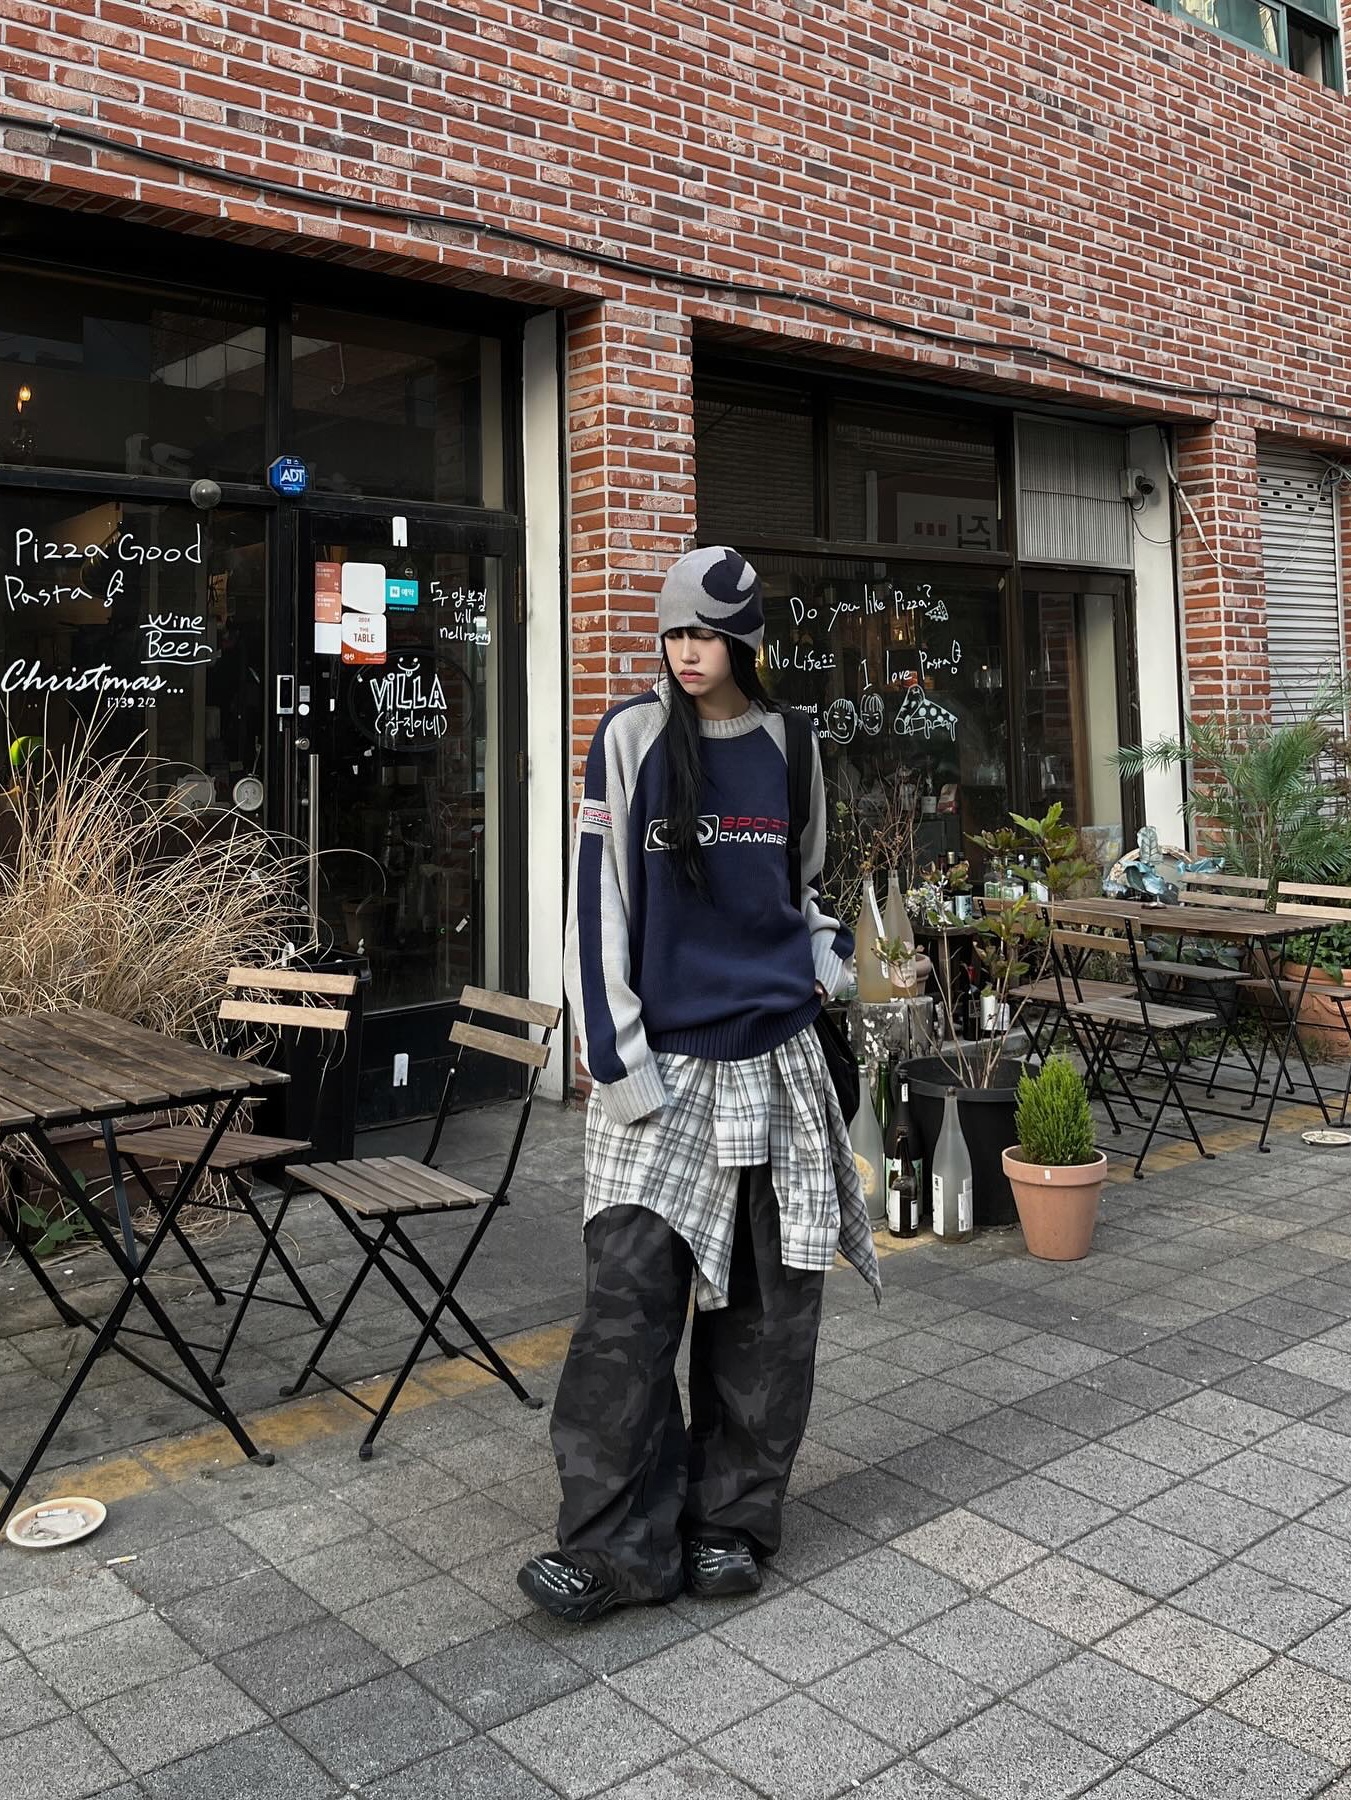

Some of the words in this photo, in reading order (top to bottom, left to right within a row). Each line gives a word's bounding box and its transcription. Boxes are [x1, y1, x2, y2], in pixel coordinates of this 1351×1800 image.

[281, 468, 305, 482] ADT
[16, 528, 109, 566] Pizza
[118, 523, 202, 565] Good
[5, 574, 93, 611] Pasta
[789, 596, 818, 626] Do
[827, 601, 861, 632] you
[864, 583, 886, 615] like
[145, 630, 213, 659] Beer
[354, 633, 375, 643] TABLE
[768, 639, 790, 670] No
[794, 644, 823, 672] Life
[860, 658, 873, 691] I
[885, 649, 912, 685] love
[813, 717, 819, 727] a
